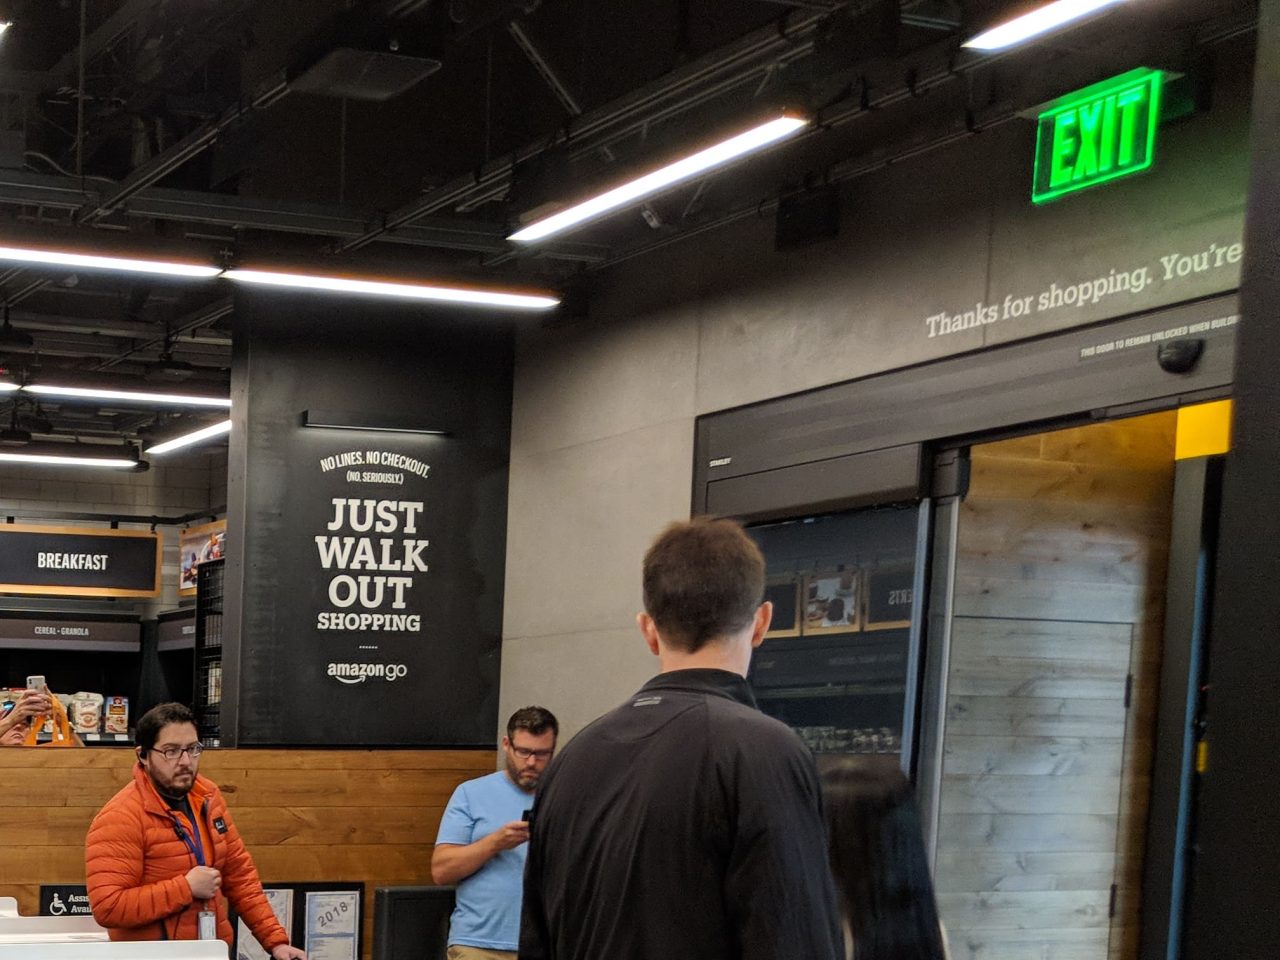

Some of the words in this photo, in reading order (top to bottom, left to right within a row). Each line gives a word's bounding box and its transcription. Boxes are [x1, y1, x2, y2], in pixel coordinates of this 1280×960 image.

[1049, 84, 1145, 188] EXIT
[925, 305, 999, 338] Thanks
[1001, 295, 1035, 321] for
[1037, 265, 1153, 308] shopping.
[1160, 242, 1244, 281] You're
[1080, 346, 1096, 358] THIS
[1096, 343, 1115, 355] DOOR
[1115, 340, 1125, 350] TO
[1125, 334, 1152, 349] REMAIN
[1151, 326, 1189, 343] UNLOCKED
[1188, 320, 1211, 334] WHEN
[320, 456, 336, 473] NO
[335, 450, 366, 468] LINES.
[365, 450, 381, 465] NO
[380, 451, 431, 479] CHECKOUT.
[346, 470, 362, 483] (NO.
[362, 471, 405, 485] SERIOUSLY.)
[327, 497, 425, 534] JUST
[37, 552, 109, 571] BREAKFAST
[314, 535, 430, 572] WALK
[328, 574, 413, 609] OUT
[34, 626, 57, 635] CEREAL
[60, 626, 90, 637] GRANOLA
[317, 612, 421, 632] SHOPPING
[327, 663, 385, 681] amazon
[385, 664, 408, 682] go
[317, 901, 349, 927] 2018
